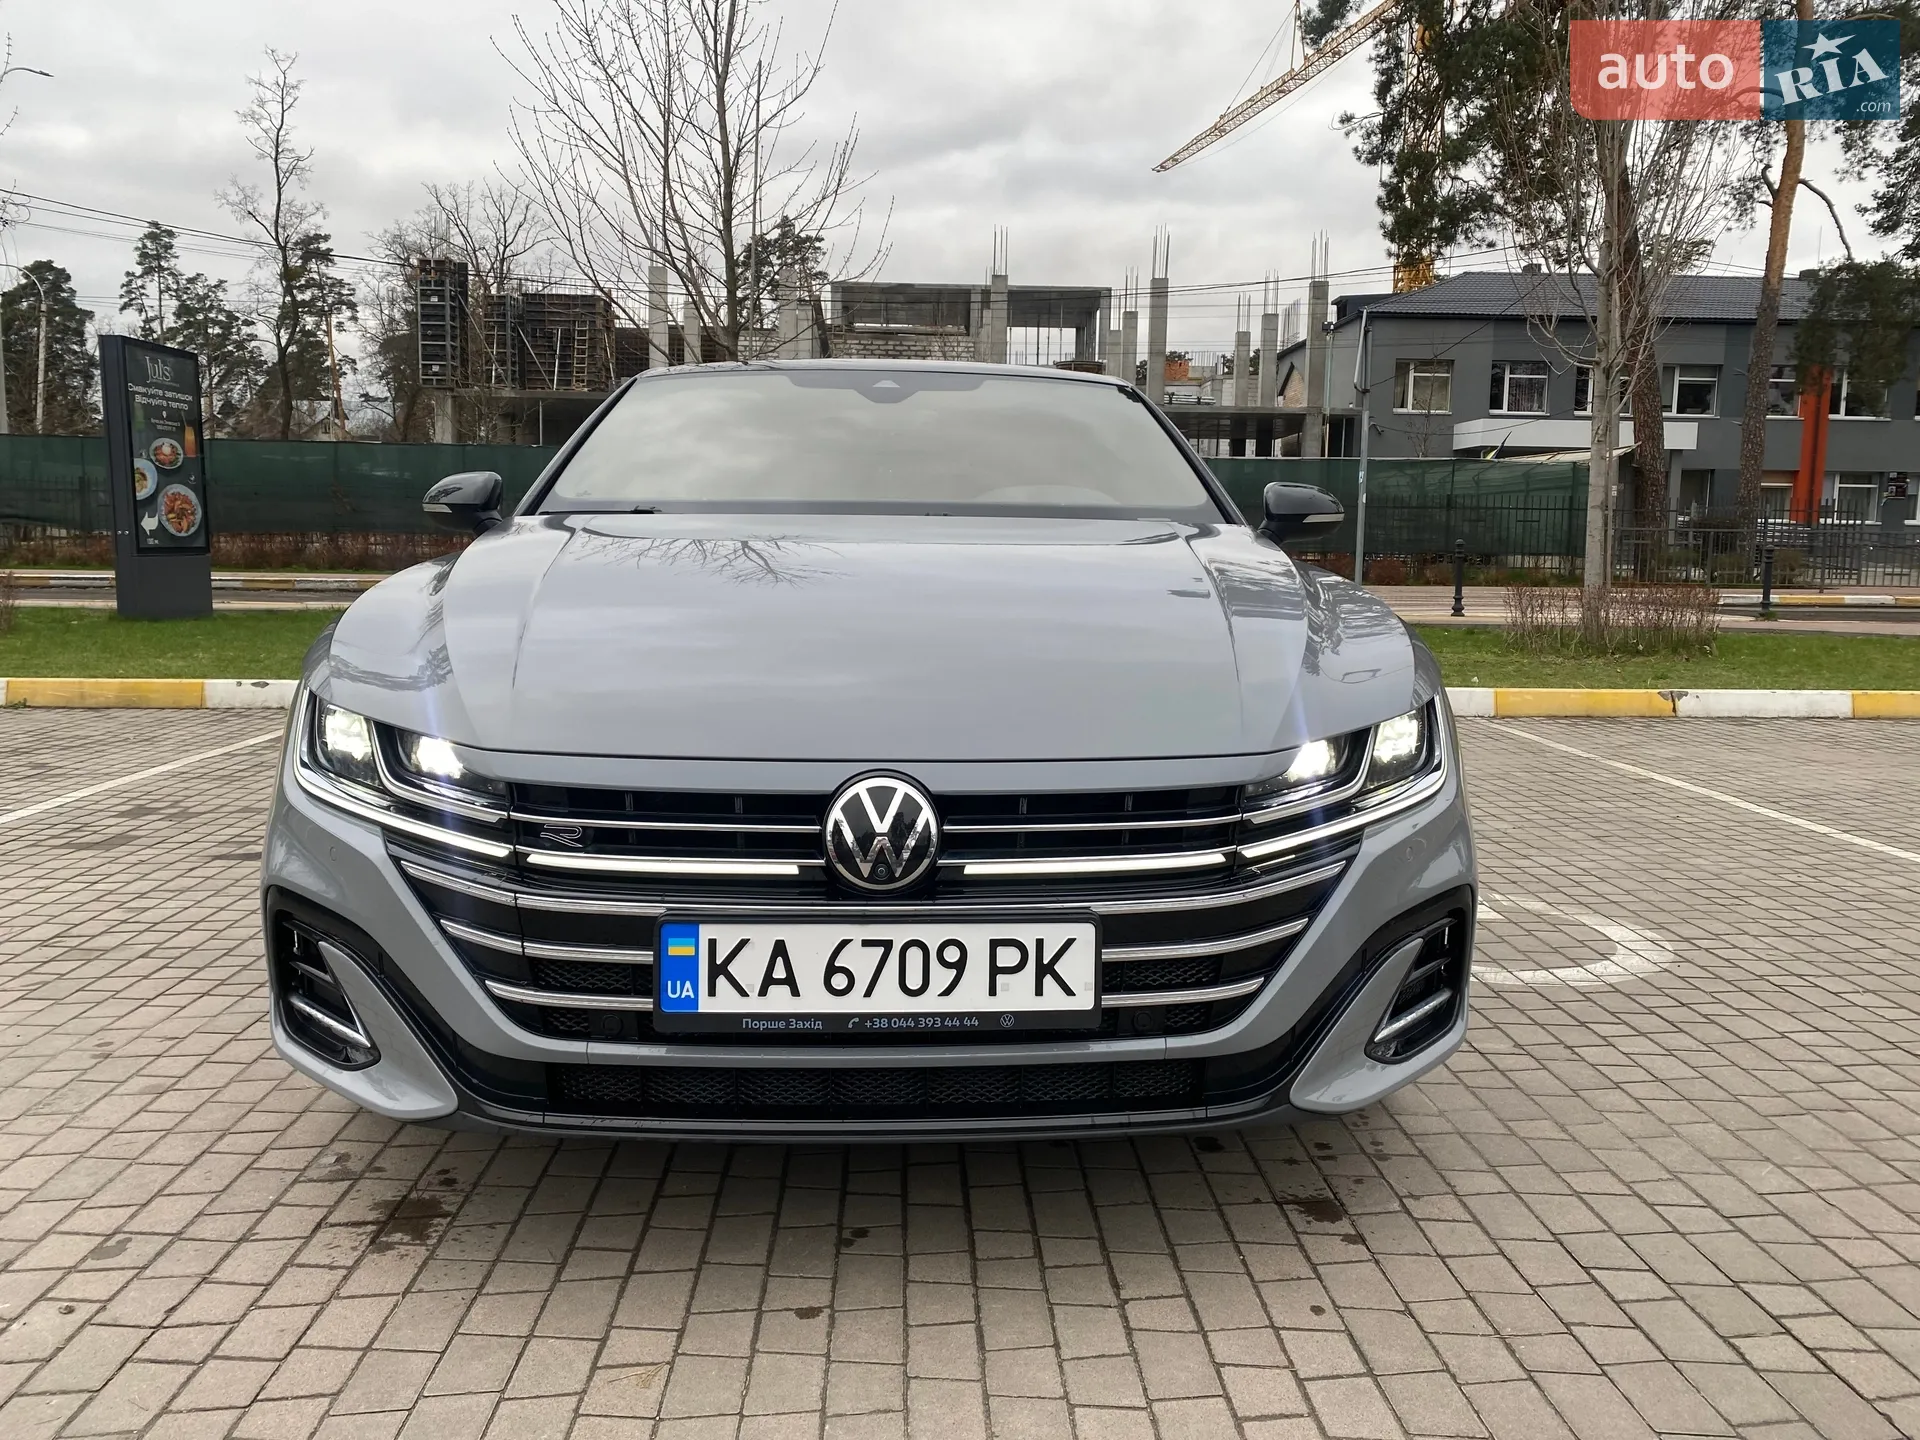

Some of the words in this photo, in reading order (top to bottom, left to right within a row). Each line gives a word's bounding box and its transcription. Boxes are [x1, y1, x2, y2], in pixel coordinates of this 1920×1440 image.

[128, 383, 163, 395] Смакуйте
[164, 391, 193, 401] затишок
[135, 395, 167, 406] Відчуйте
[168, 401, 188, 410] тепло
[706, 937, 802, 998] KA
[823, 937, 969, 998] 6709
[988, 937, 1078, 998] PK
[667, 981, 695, 1000] UA
[742, 1018, 786, 1031] Порше
[789, 1018, 823, 1031] Захід
[864, 1018, 888, 1029] +38
[891, 1017, 914, 1028] 044
[916, 1017, 941, 1028] 393
[943, 1017, 961, 1028] 44
[963, 1016, 979, 1028] 44
